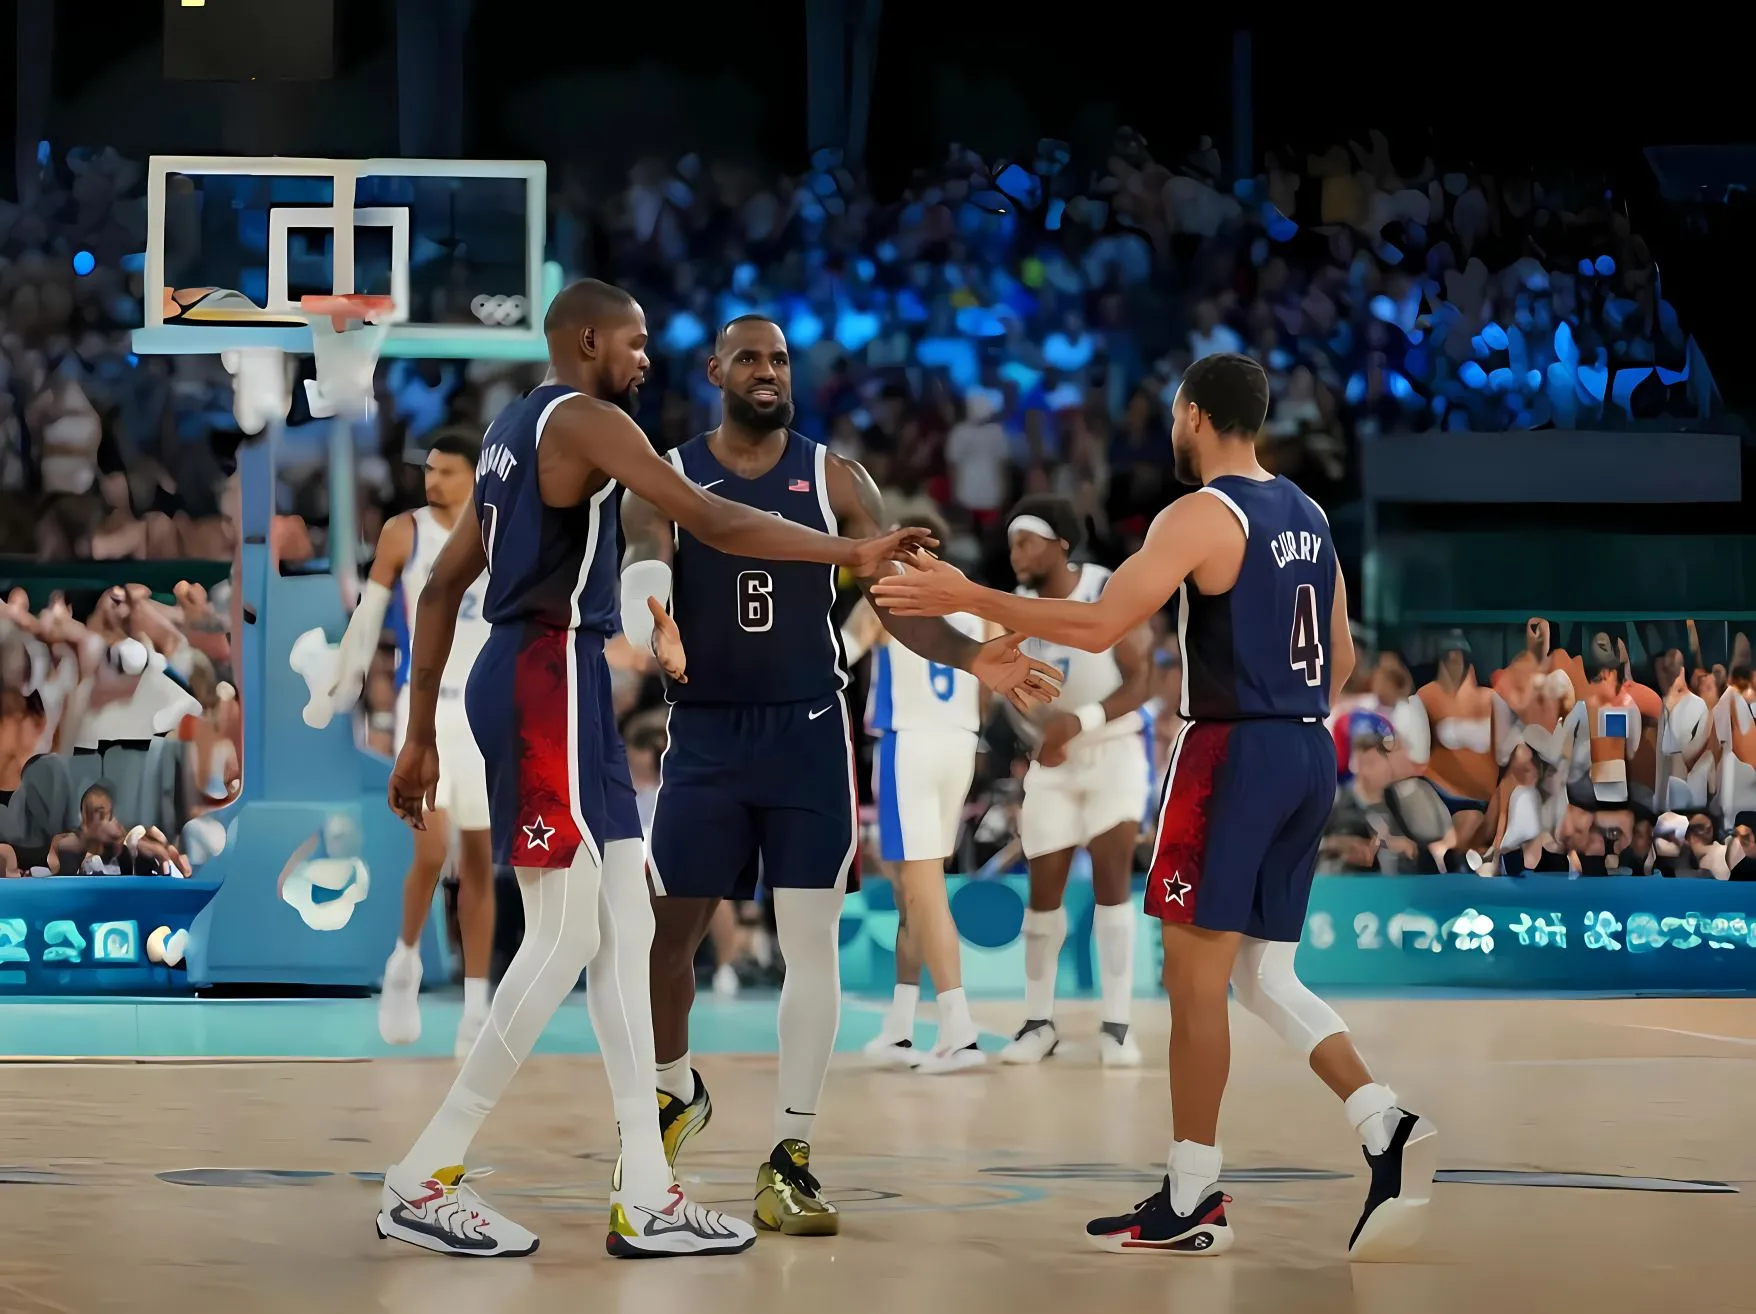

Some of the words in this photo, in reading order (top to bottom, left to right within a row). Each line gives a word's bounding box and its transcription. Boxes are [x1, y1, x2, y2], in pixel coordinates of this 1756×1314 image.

[1270, 531, 1322, 569] CURRY
[737, 570, 773, 632] 6
[1289, 583, 1324, 687] 4
